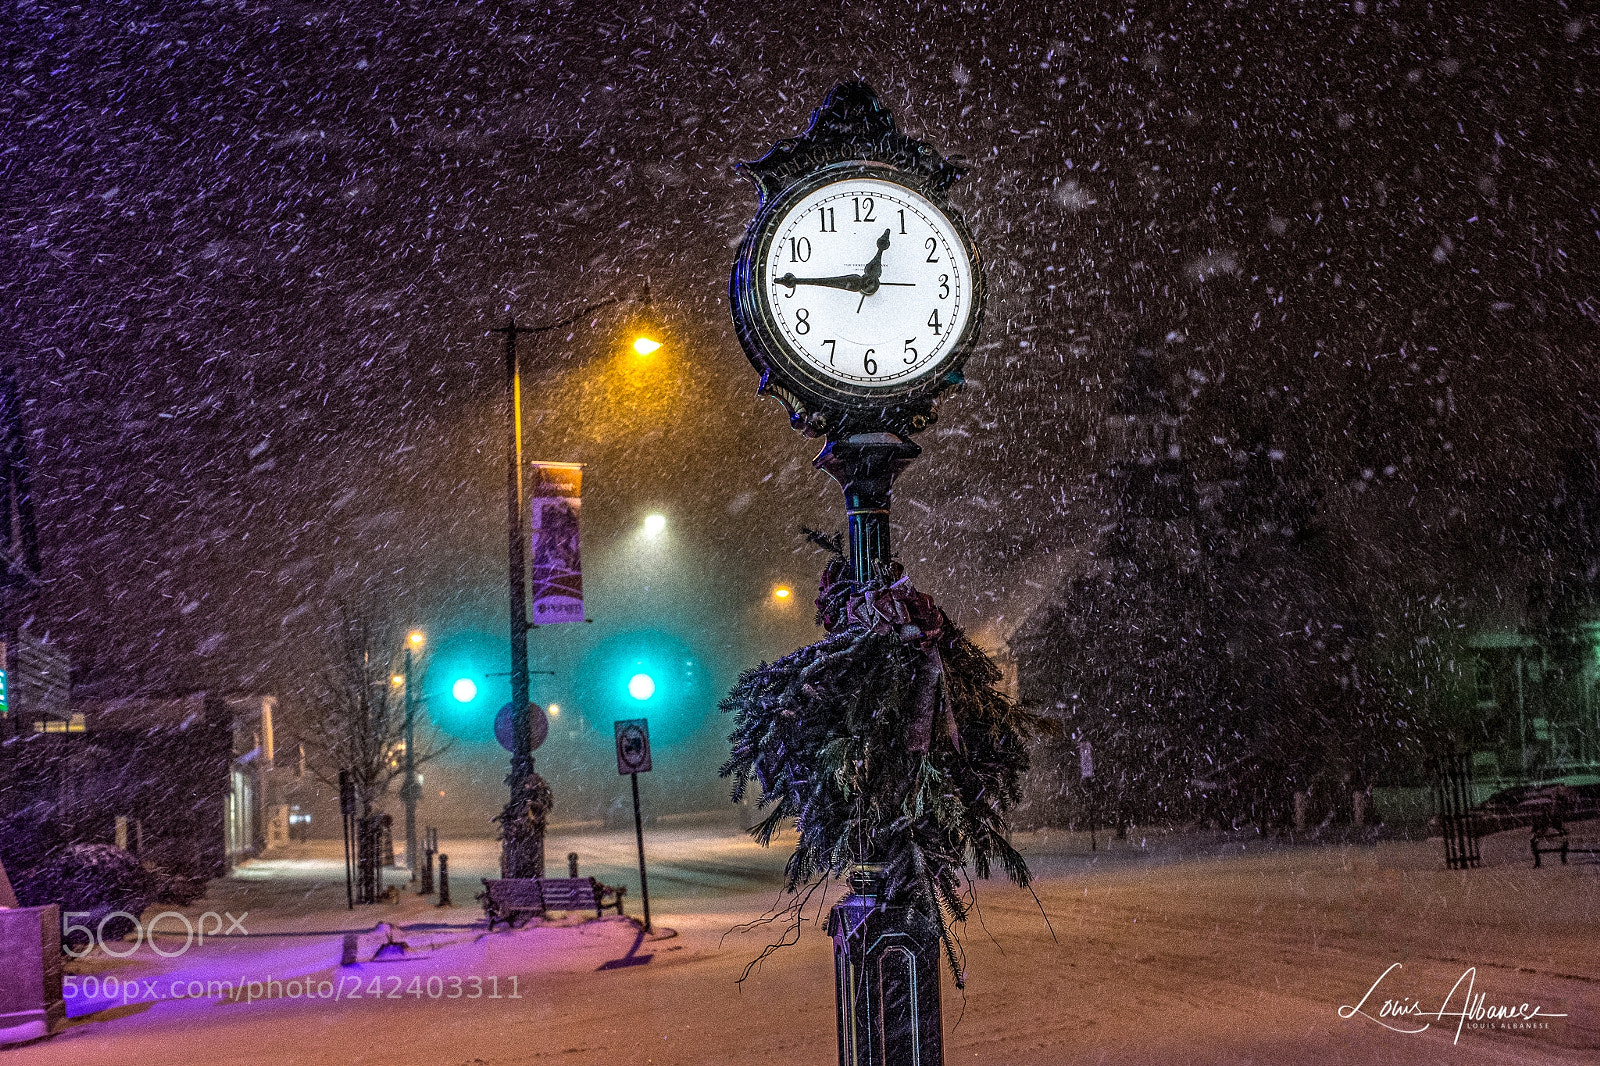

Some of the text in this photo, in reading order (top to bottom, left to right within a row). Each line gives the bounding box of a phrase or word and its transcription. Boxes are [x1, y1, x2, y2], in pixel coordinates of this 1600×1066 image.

[817, 206, 837, 232] 11
[852, 196, 877, 222] 12
[898, 209, 907, 234] 1
[789, 237, 811, 262] 10
[925, 236, 940, 263] 2
[939, 274, 949, 299] 3
[796, 308, 810, 335] 8
[928, 309, 942, 335] 4
[819, 340, 835, 366] 7
[864, 349, 877, 375] 6
[904, 337, 918, 365] 5
